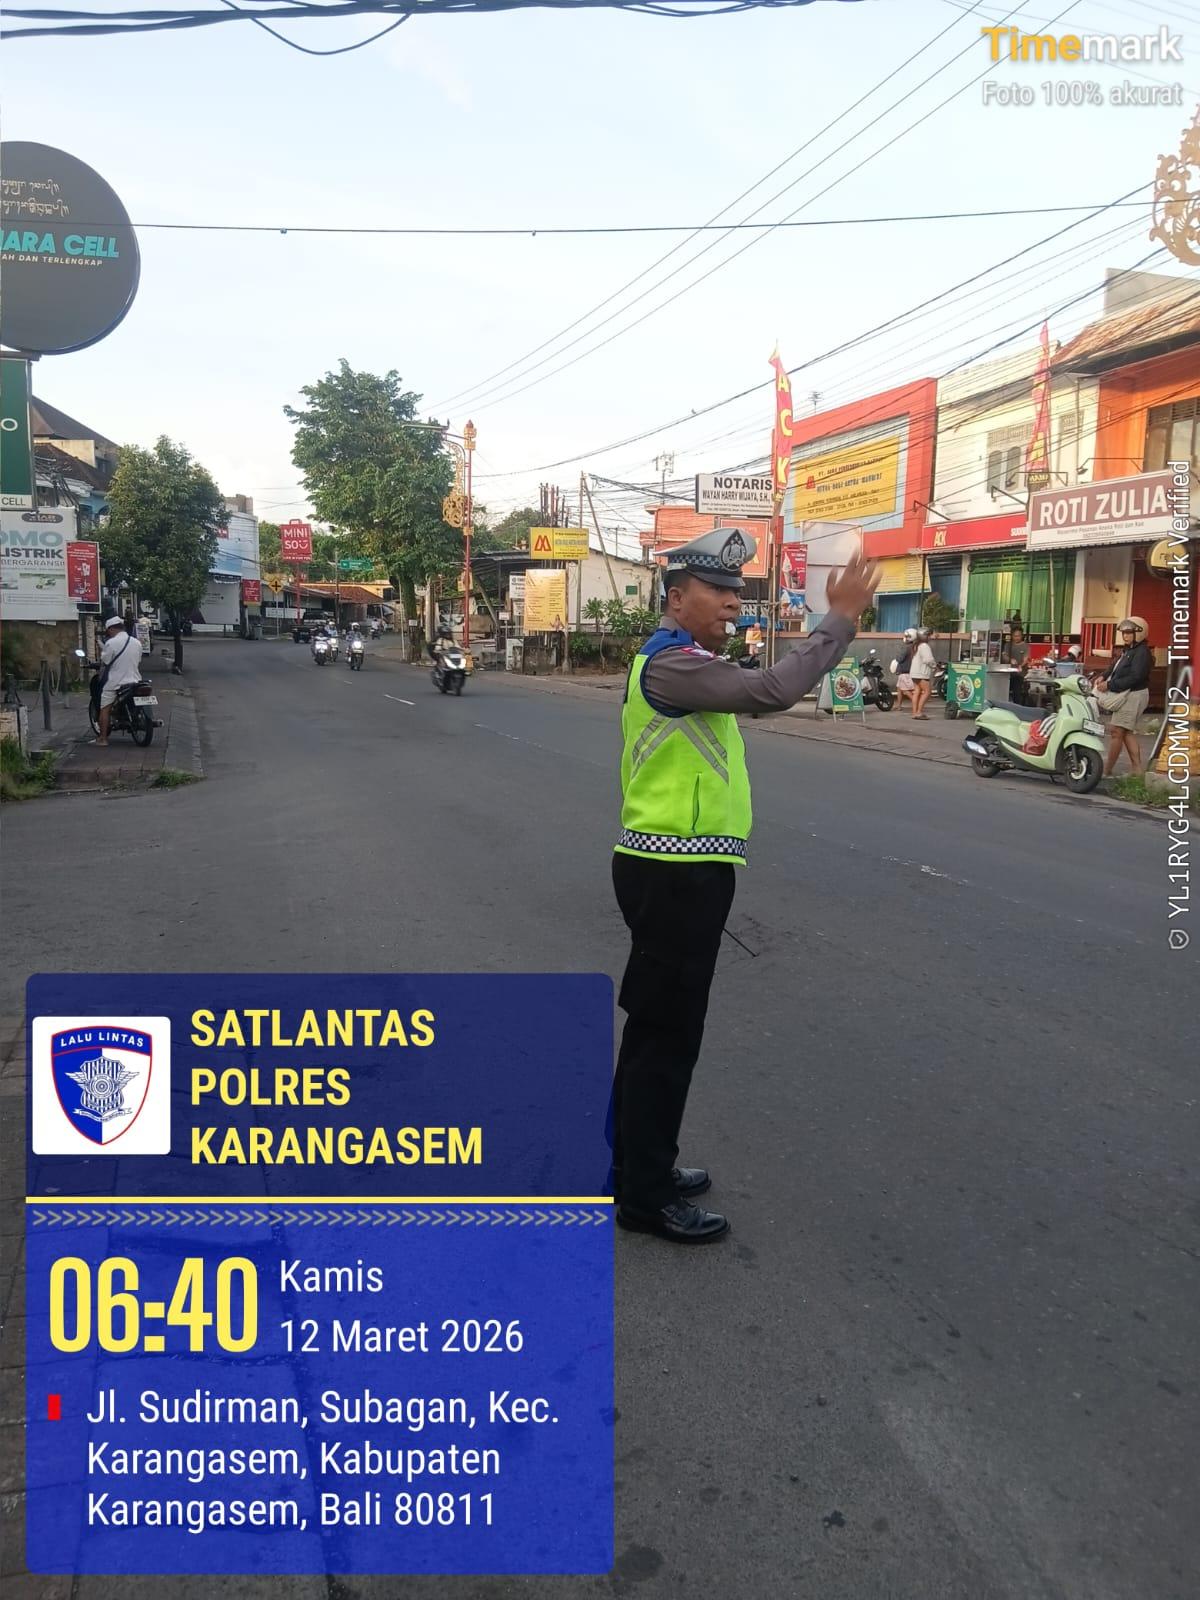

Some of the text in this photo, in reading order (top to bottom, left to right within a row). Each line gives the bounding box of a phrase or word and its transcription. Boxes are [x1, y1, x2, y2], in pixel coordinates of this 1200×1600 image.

[0, 227, 119, 258] ARA CELL
[18, 254, 38, 262] DAN
[43, 256, 103, 267] TERLENGKAP
[714, 477, 773, 490] NOTARIS
[1, 497, 26, 506] CELL
[1040, 485, 1169, 527] ROTI ZULIA
[284, 528, 308, 538] MINI
